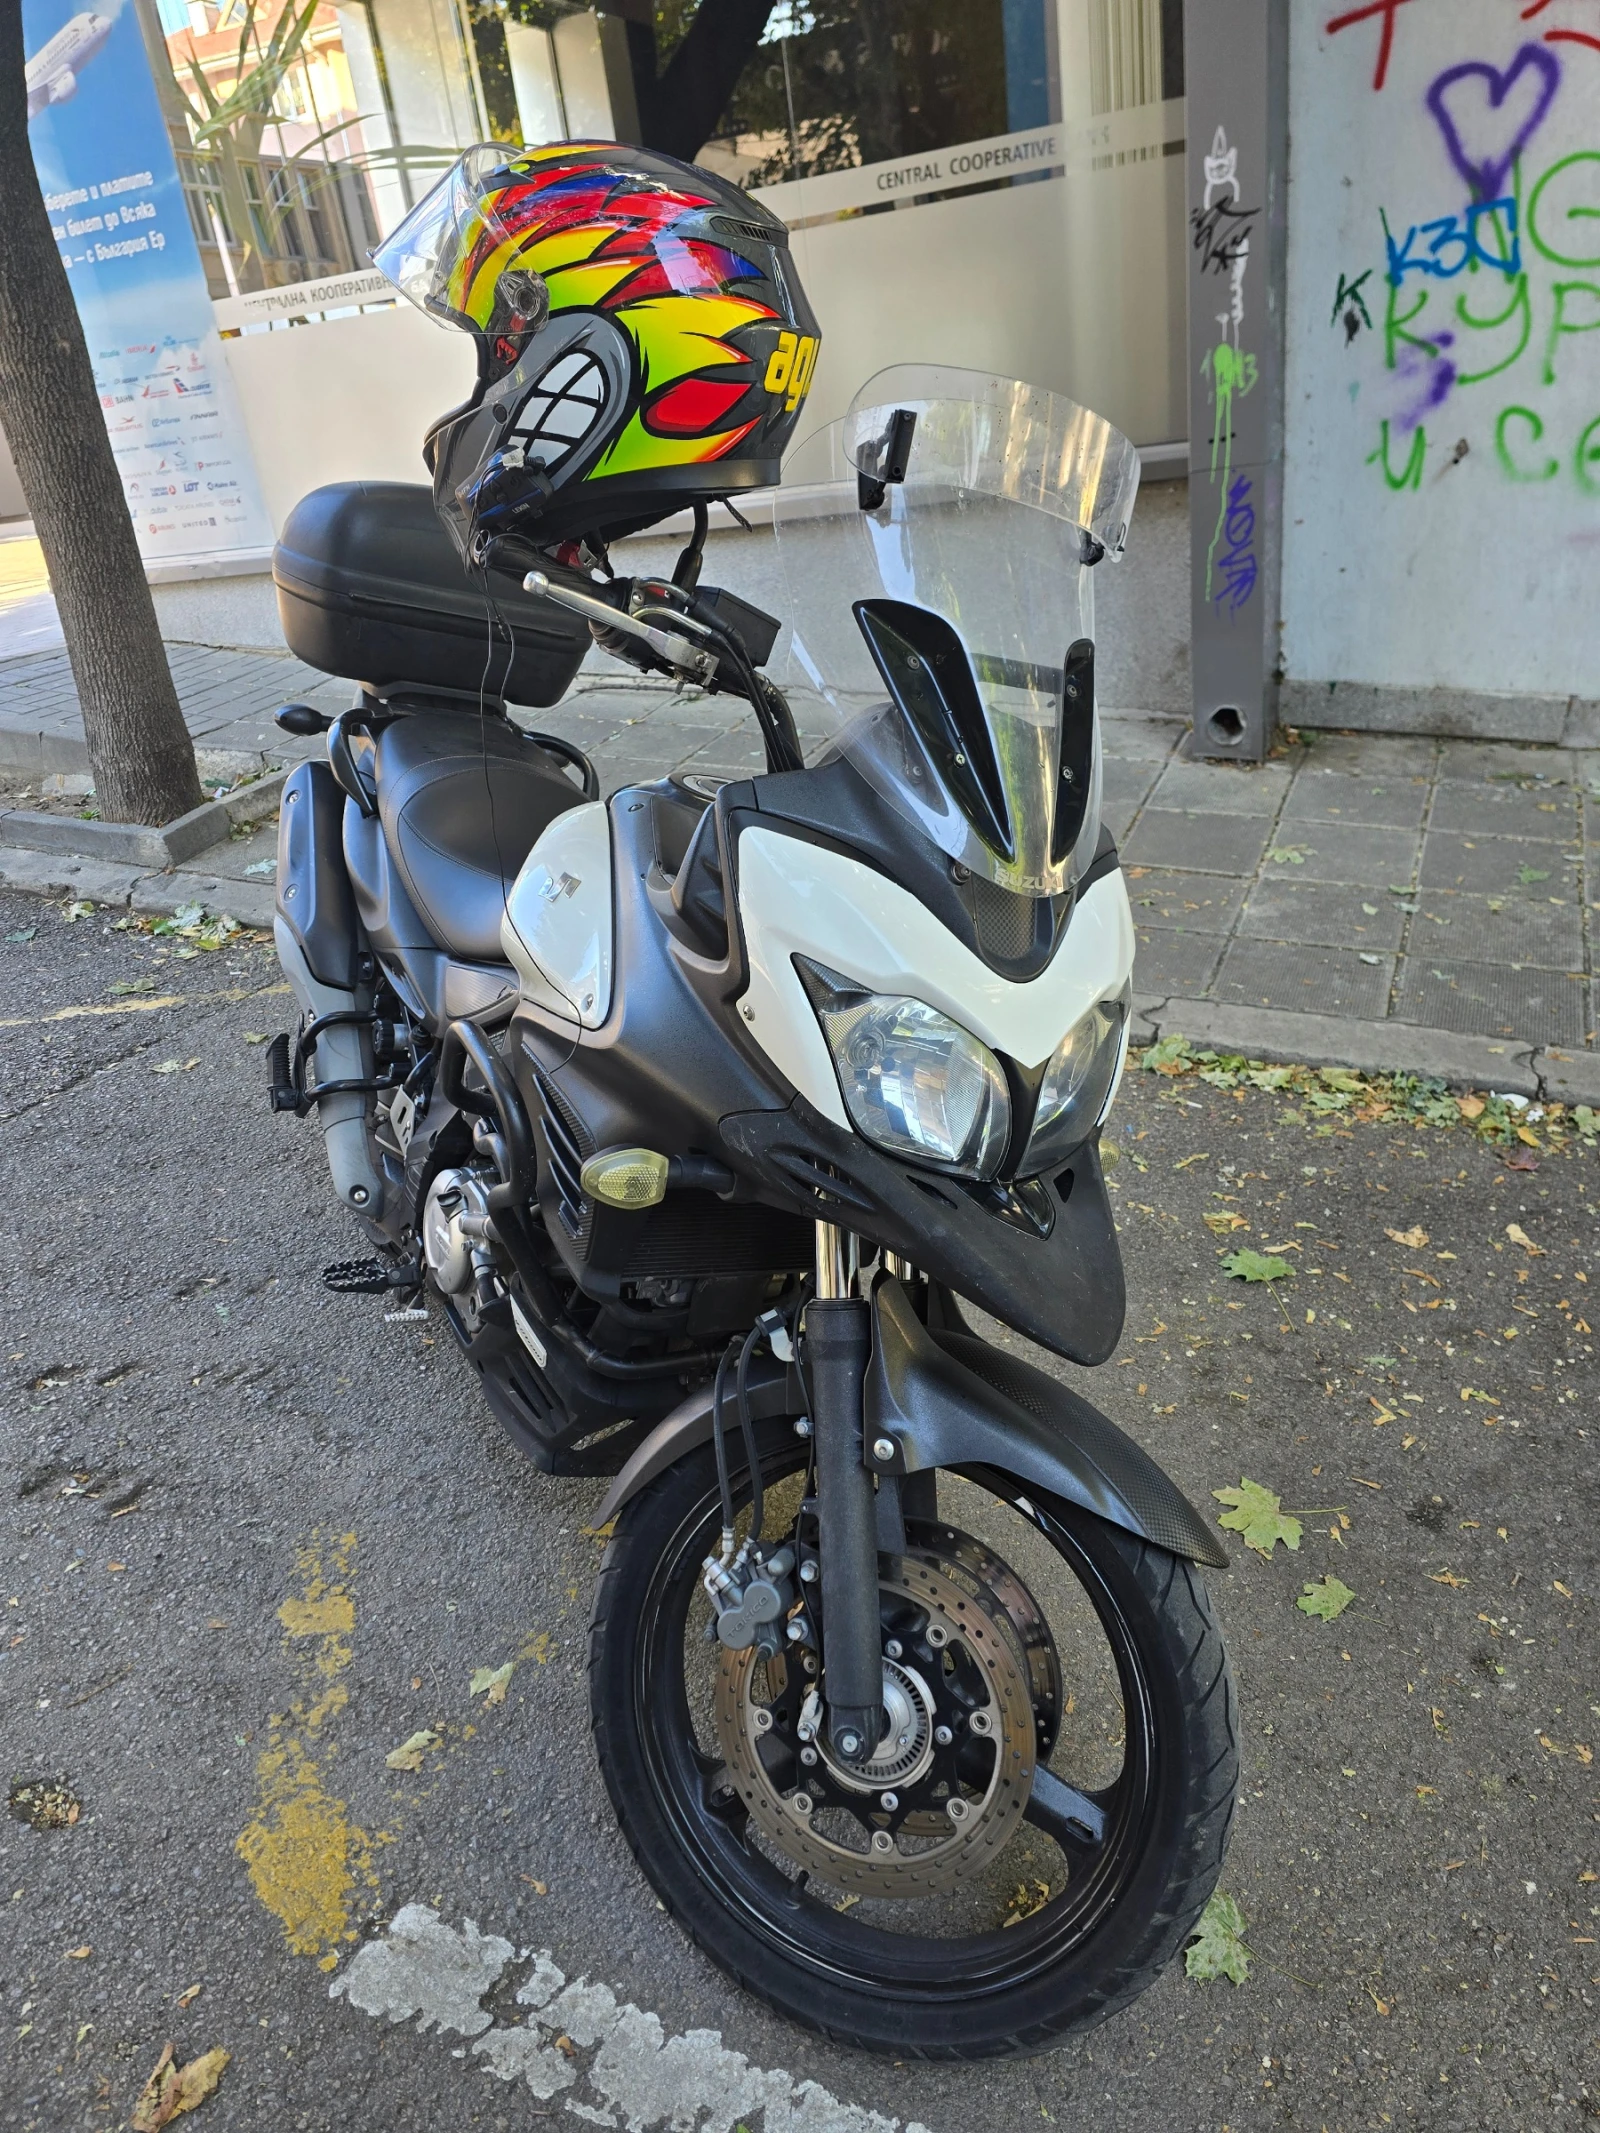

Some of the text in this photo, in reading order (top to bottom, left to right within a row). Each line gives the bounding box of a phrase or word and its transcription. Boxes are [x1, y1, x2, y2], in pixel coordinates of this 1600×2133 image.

[876, 137, 1056, 191] CENTRAL COOPERATIVE
[43, 188, 89, 212] берете
[89, 185, 99, 200] и
[52, 225, 67, 241] ен
[66, 214, 104, 237] билет
[104, 212, 120, 231] до
[86, 249, 95, 263] с
[94, 236, 149, 261] България
[310, 275, 393, 303] КООПЕРАТИВН
[183, 481, 200, 493] LOT
[181, 519, 209, 529] UNITED
[995, 867, 1064, 890] SUZUKI
[727, 1595, 769, 1639] TOKICO
